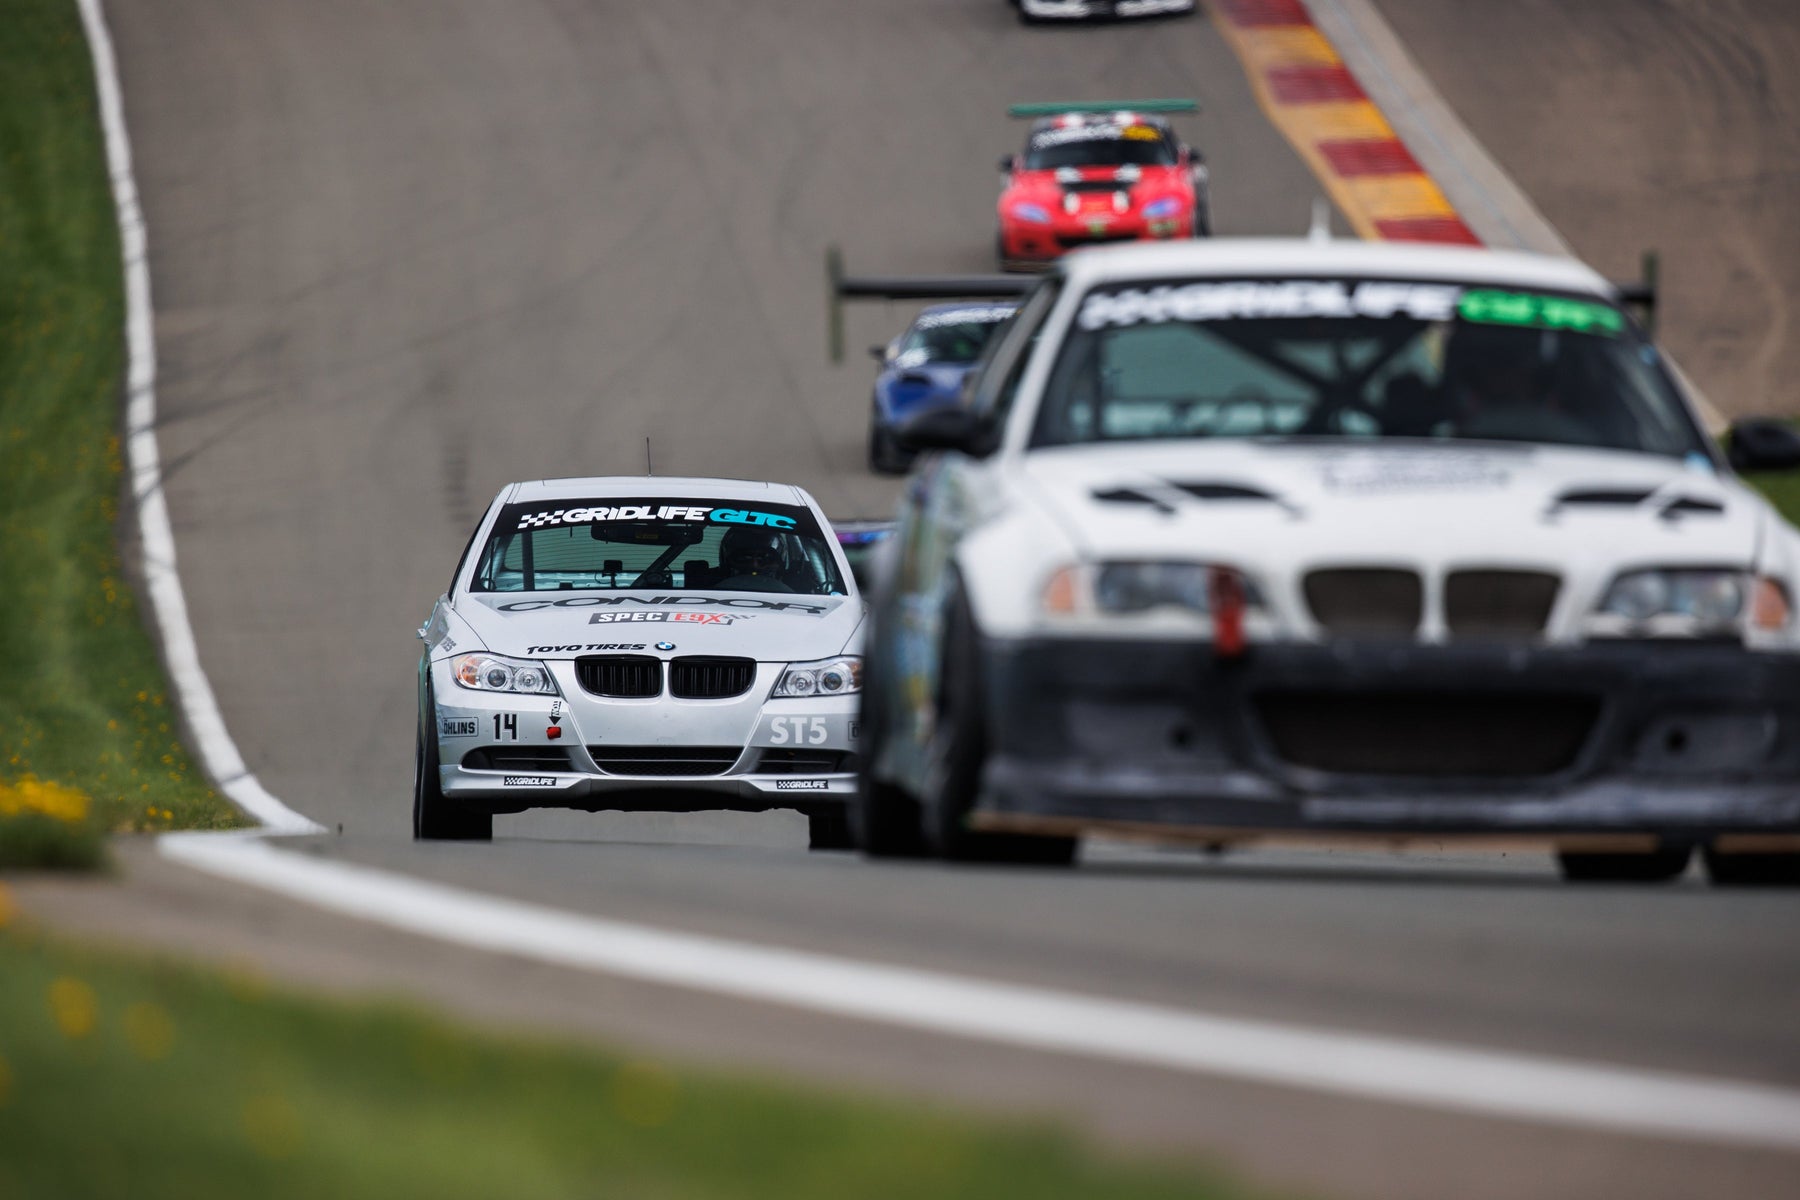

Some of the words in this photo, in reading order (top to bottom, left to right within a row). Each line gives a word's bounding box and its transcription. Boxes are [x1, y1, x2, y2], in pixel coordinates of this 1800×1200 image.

[562, 506, 713, 522] GRIDLIFE
[709, 508, 797, 530] GLTC
[497, 597, 827, 614] CONDOR
[598, 612, 663, 622] SPEC
[674, 613, 727, 625] E9X
[527, 644, 583, 655] TOYO
[585, 643, 647, 651] TIRES
[493, 713, 517, 740] 14
[769, 717, 828, 744] ST5
[517, 777, 555, 785] GRIDLIFE
[788, 781, 827, 789] GRIDLIFE
